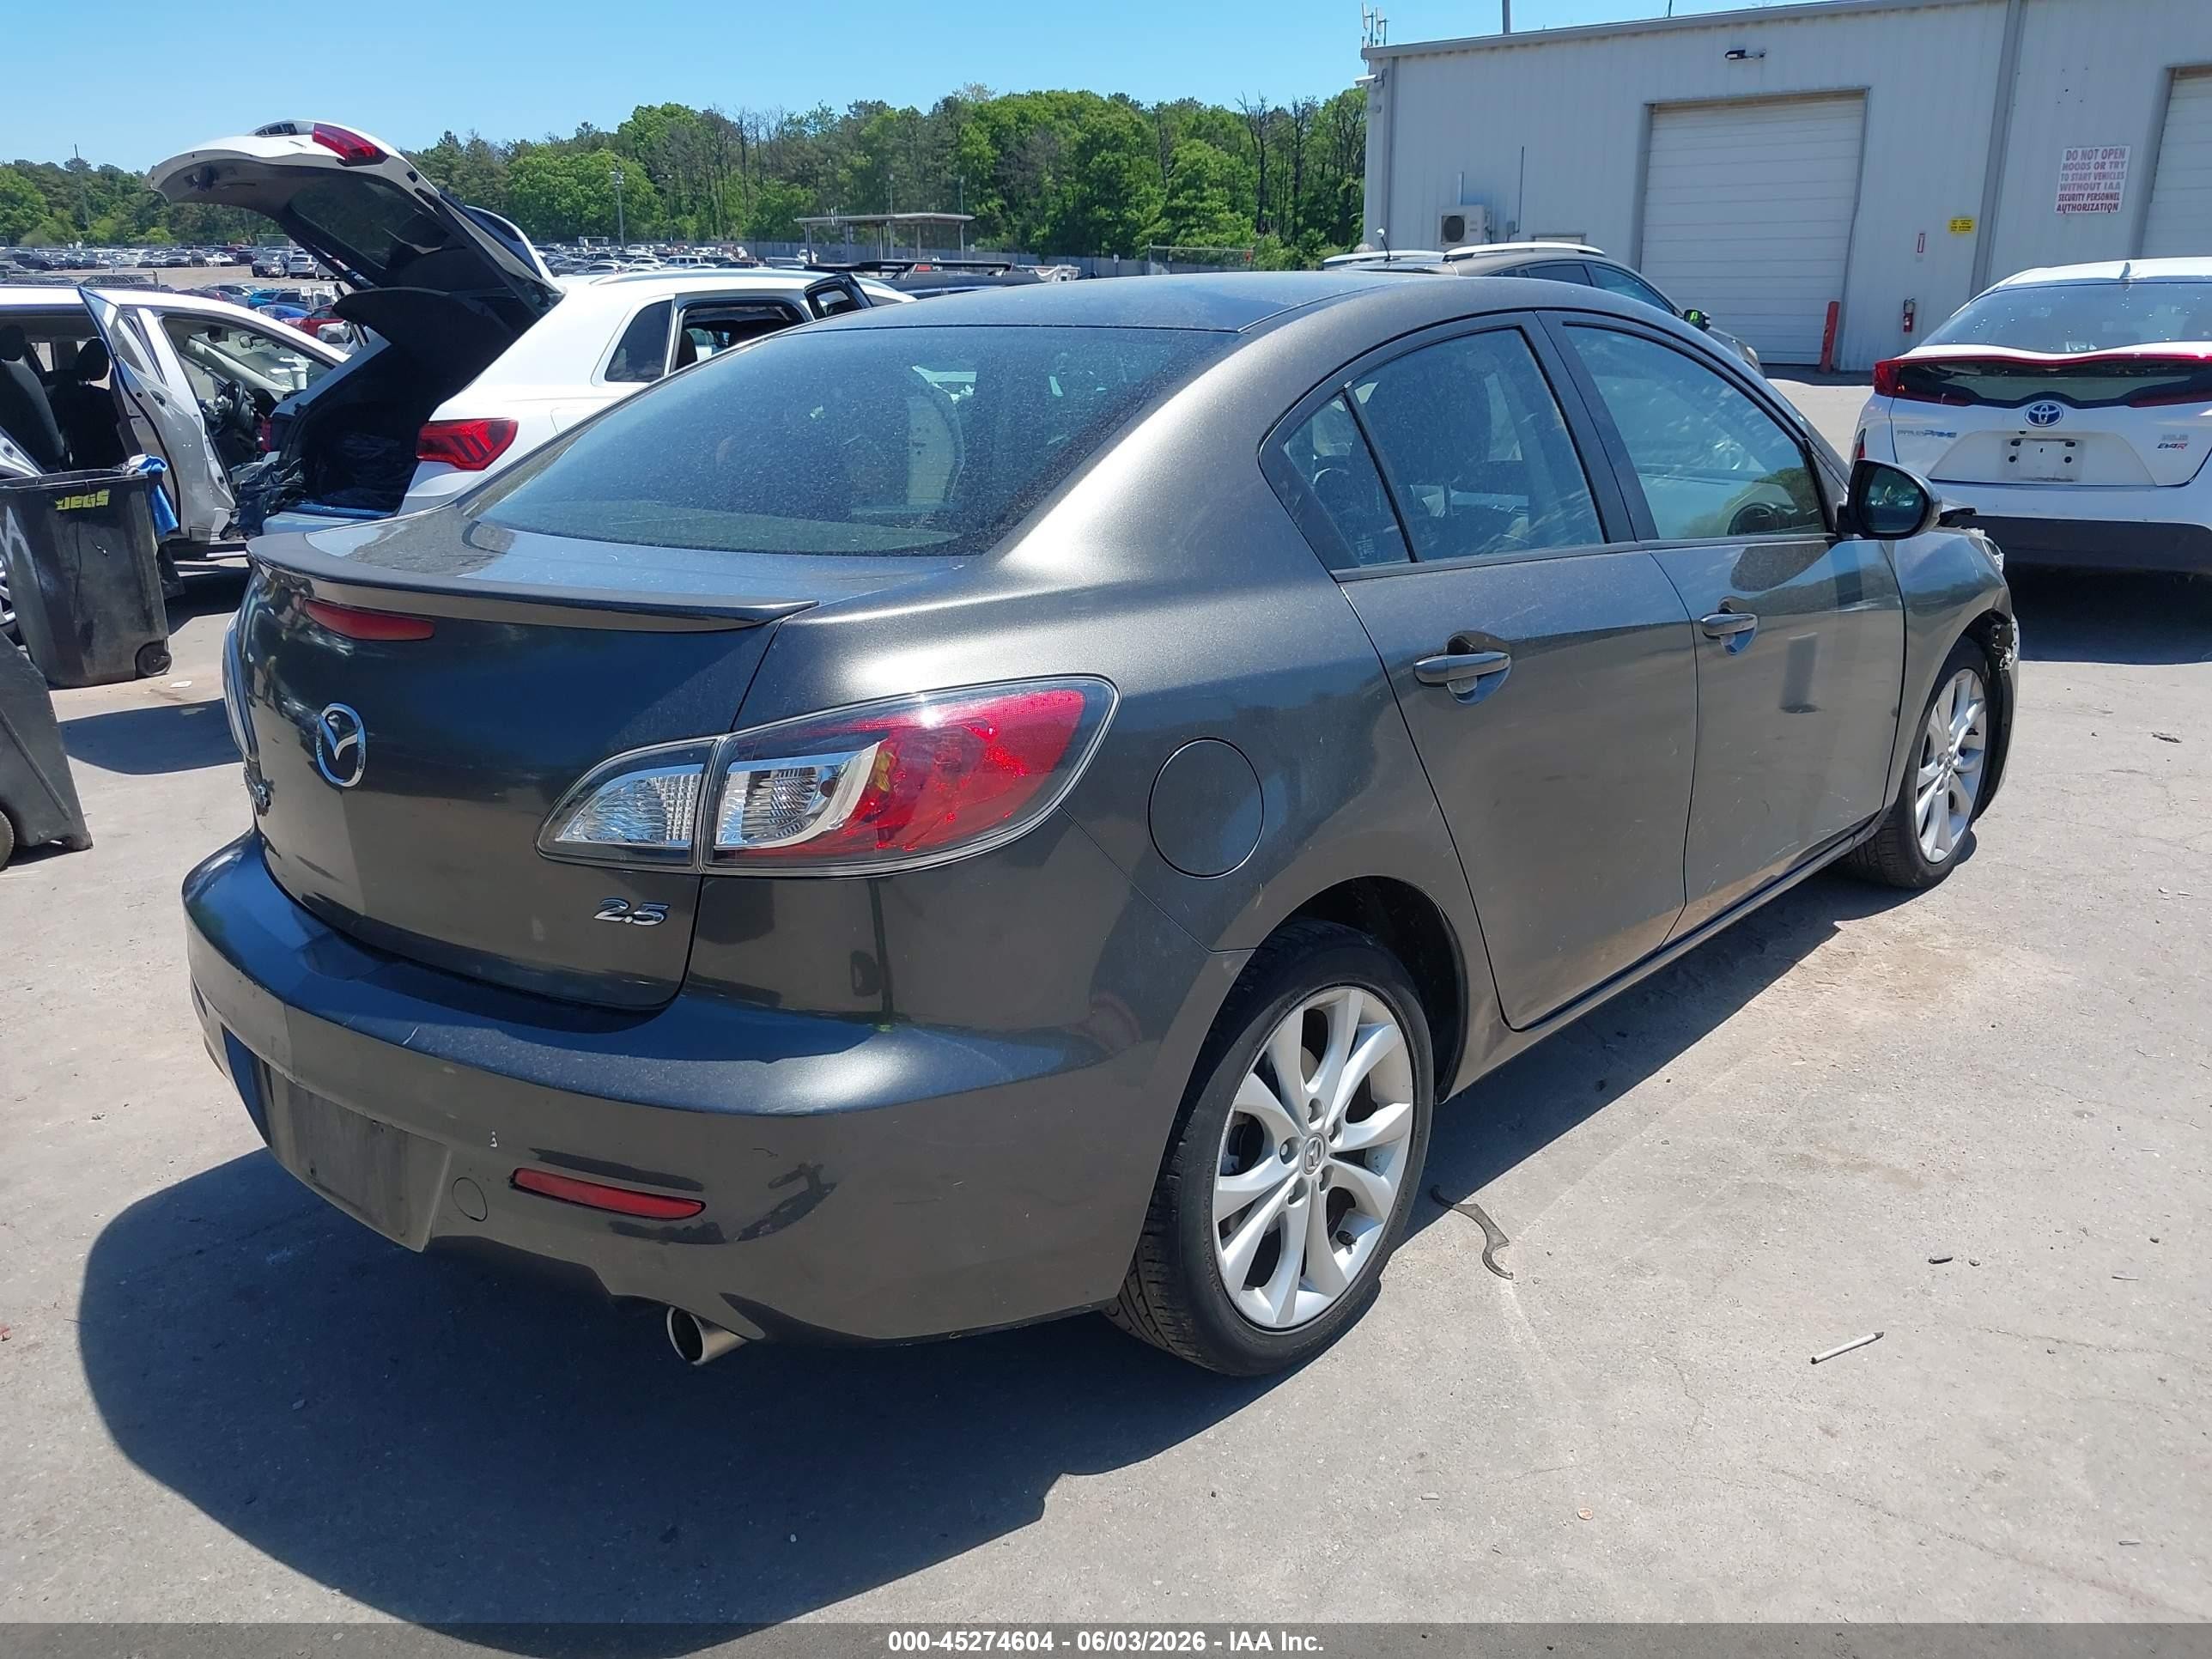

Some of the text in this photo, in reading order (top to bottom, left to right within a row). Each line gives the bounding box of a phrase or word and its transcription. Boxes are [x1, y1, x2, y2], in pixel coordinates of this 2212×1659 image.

[2066, 148, 2126, 161] DO NOT OPEN
[2094, 161, 2106, 170] OR
[2109, 161, 2126, 169] TRY
[2061, 171, 2125, 181] TO START VEHICLES
[2060, 182, 2101, 191] WITHOUT
[2058, 191, 2120, 202] SECURITY PERSONNEL
[2057, 203, 2119, 213] AUTHORIZATION
[593, 897, 670, 927] 2.5
